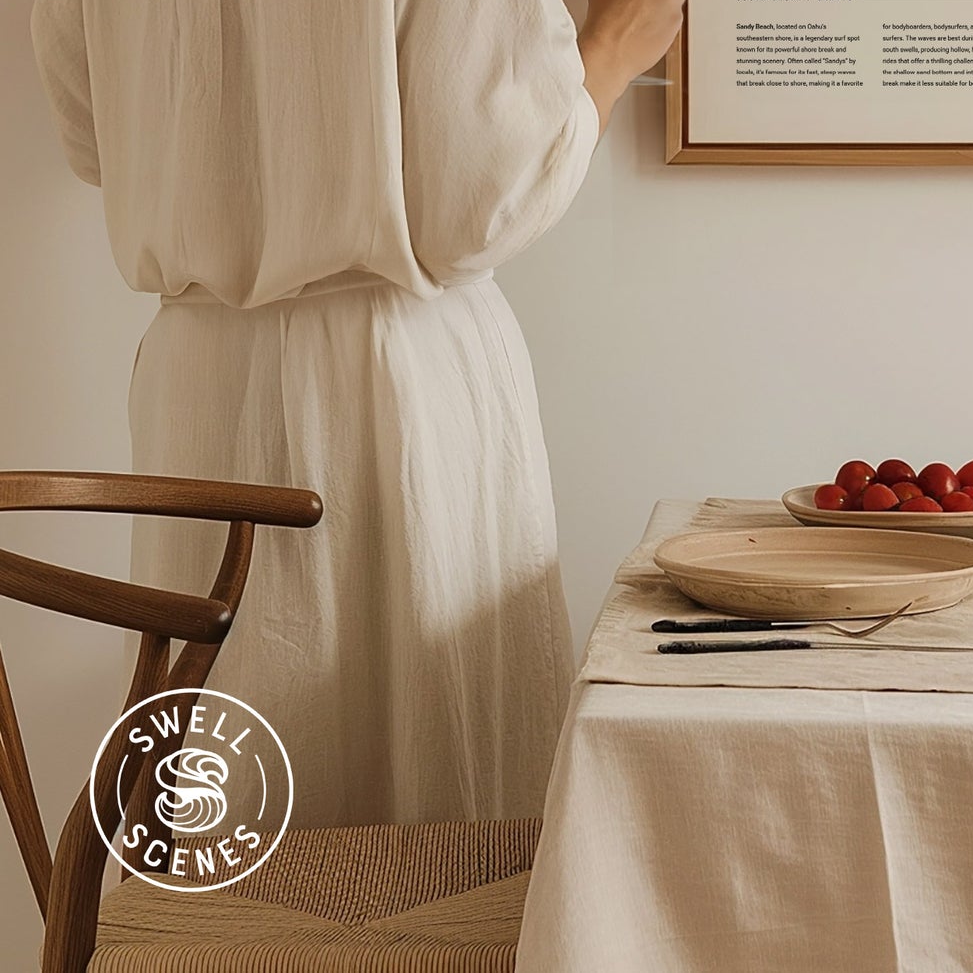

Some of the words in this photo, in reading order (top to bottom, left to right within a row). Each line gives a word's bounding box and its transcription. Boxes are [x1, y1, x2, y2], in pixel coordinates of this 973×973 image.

[736, 22, 754, 32] Sandy
[883, 22, 891, 31] for
[736, 34, 774, 42] southeastern
[805, 34, 833, 43] legendary
[834, 34, 845, 42] surf
[847, 35, 860, 43] spot
[906, 34, 916, 42] The
[948, 34, 960, 42] best
[736, 44, 755, 53] known
[757, 45, 765, 53] for
[775, 45, 800, 55] powerful
[801, 45, 817, 53] shore
[818, 45, 834, 53] break
[883, 45, 899, 54] south
[921, 46, 949, 55] producing
[736, 58, 761, 66] stunning
[805, 57, 821, 65] called
[883, 57, 897, 65] rides
[898, 57, 909, 65] that
[911, 57, 925, 65] offer
[931, 57, 952, 66] thrilling
[821, 69, 836, 77] steep
[893, 68, 915, 76] shallow
[916, 68, 931, 76] sand
[932, 68, 952, 76] bottom
[736, 79, 748, 87] that
[749, 79, 765, 87] break
[767, 79, 782, 87] close
[809, 79, 830, 89] making
[842, 79, 863, 87] favorite
[883, 79, 898, 89] break
[900, 79, 916, 87] make
[922, 79, 934, 87] less
[935, 79, 958, 87] suitable
[959, 79, 967, 87] for
